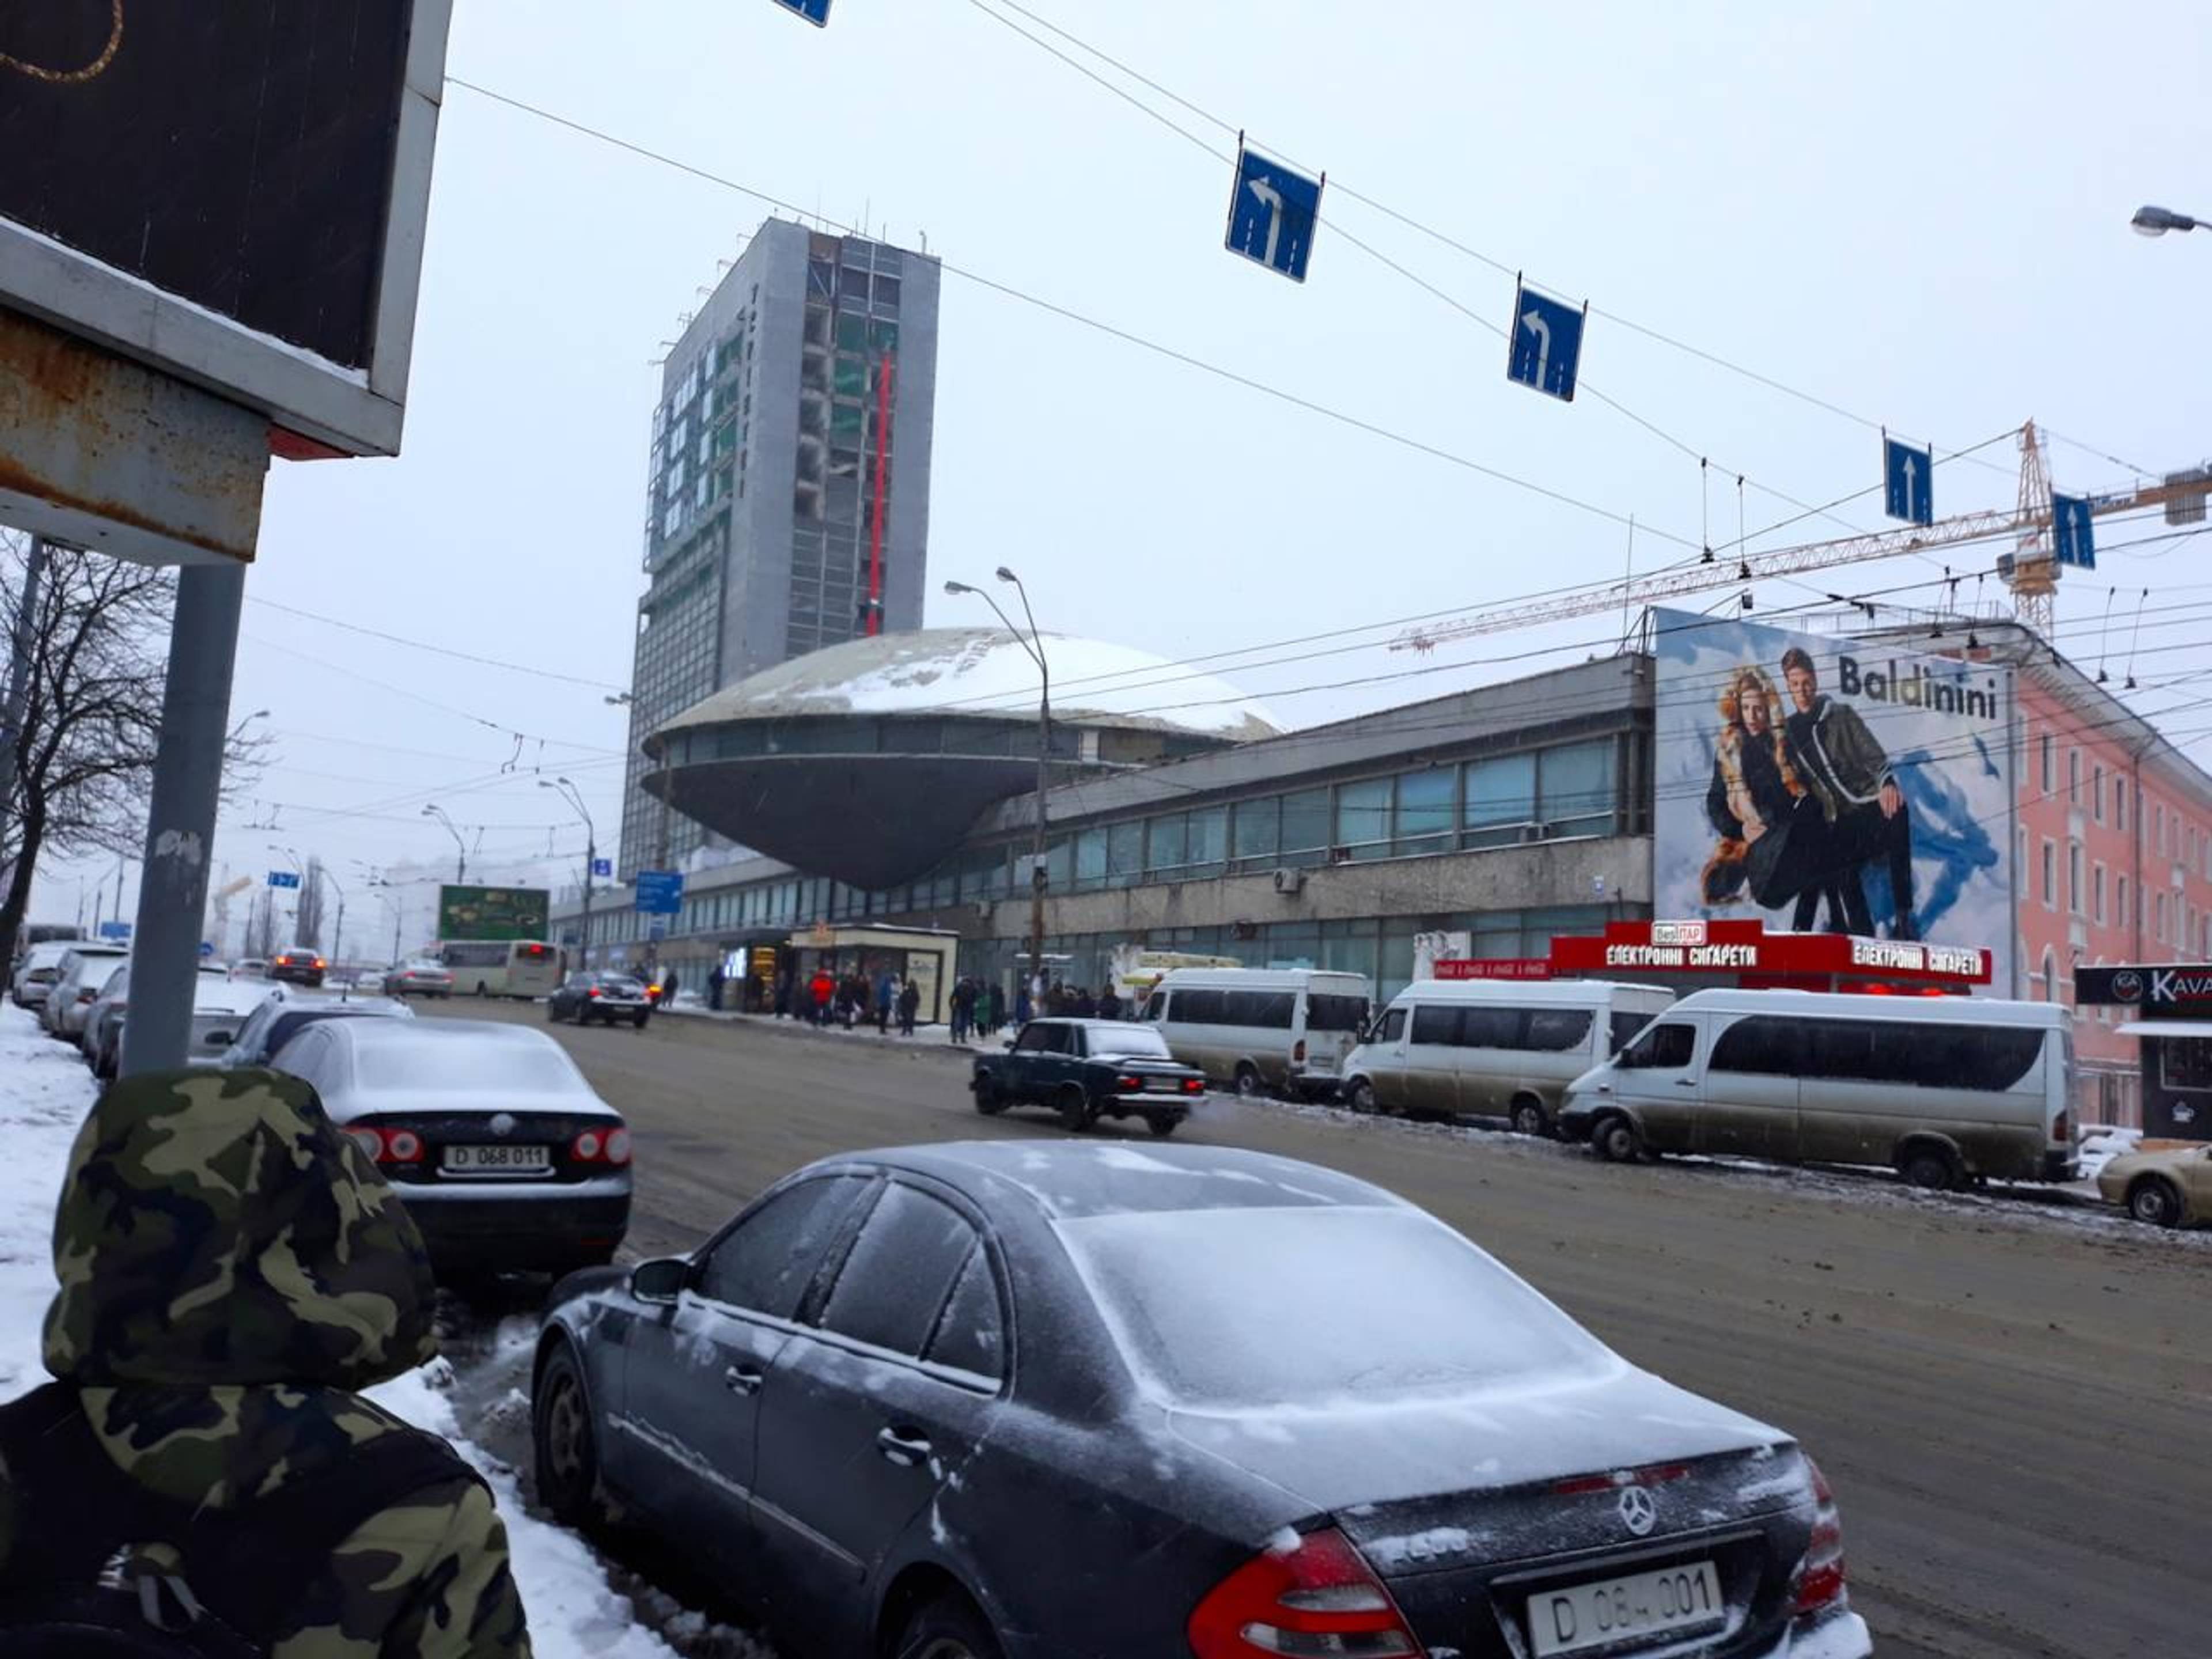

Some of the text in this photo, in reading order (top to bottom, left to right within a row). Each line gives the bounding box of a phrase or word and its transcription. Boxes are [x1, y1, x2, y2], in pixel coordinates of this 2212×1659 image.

[1839, 655, 1995, 719] Baldinini
[1606, 944, 1757, 967] ЕЛЕКТРОННІ СИГАРЕТИ
[456, 1148, 468, 1164] D
[1552, 1596, 1577, 1643] D
